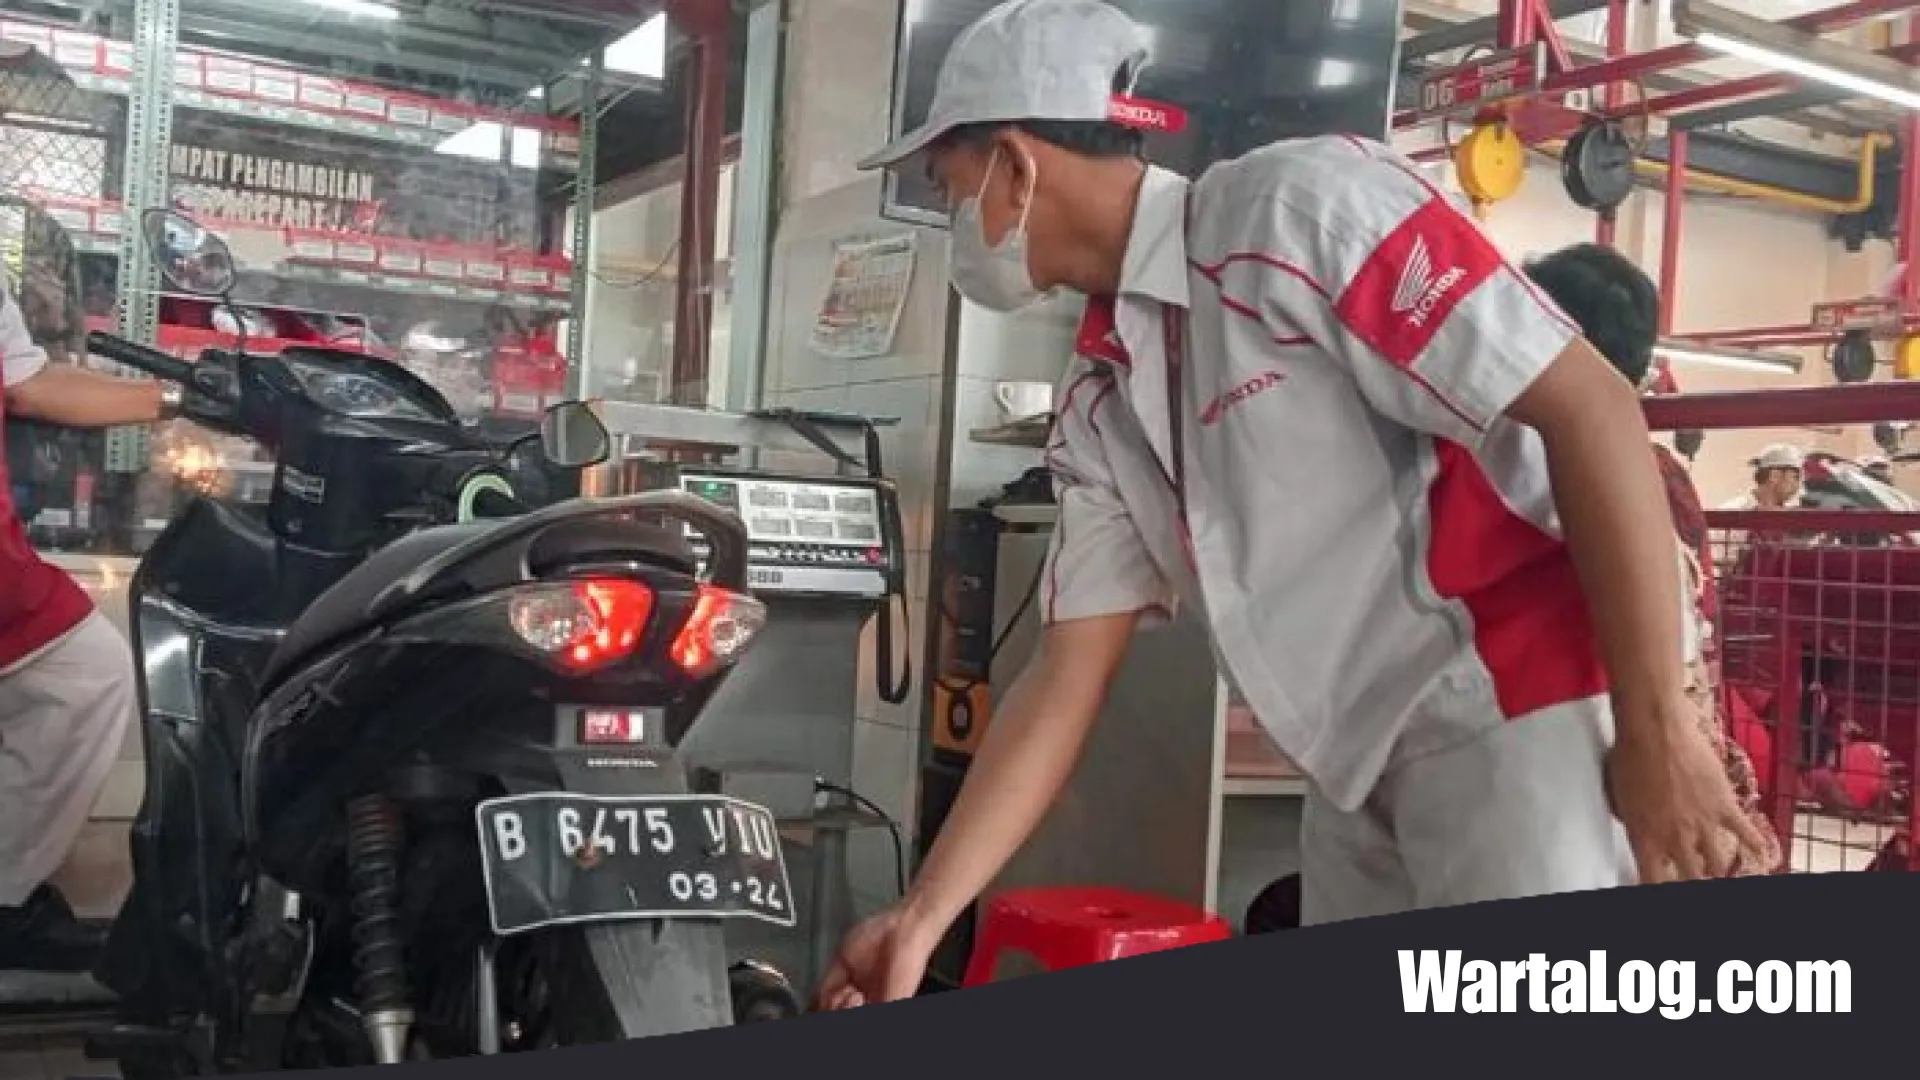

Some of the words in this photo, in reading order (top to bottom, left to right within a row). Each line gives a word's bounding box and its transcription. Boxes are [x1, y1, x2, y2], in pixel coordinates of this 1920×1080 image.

[1111, 101, 1166, 127] ONDA
[231, 153, 373, 201] PENGAMBILAN
[1406, 266, 1467, 328] HONDA
[494, 810, 526, 861] B
[557, 807, 674, 855] 6475
